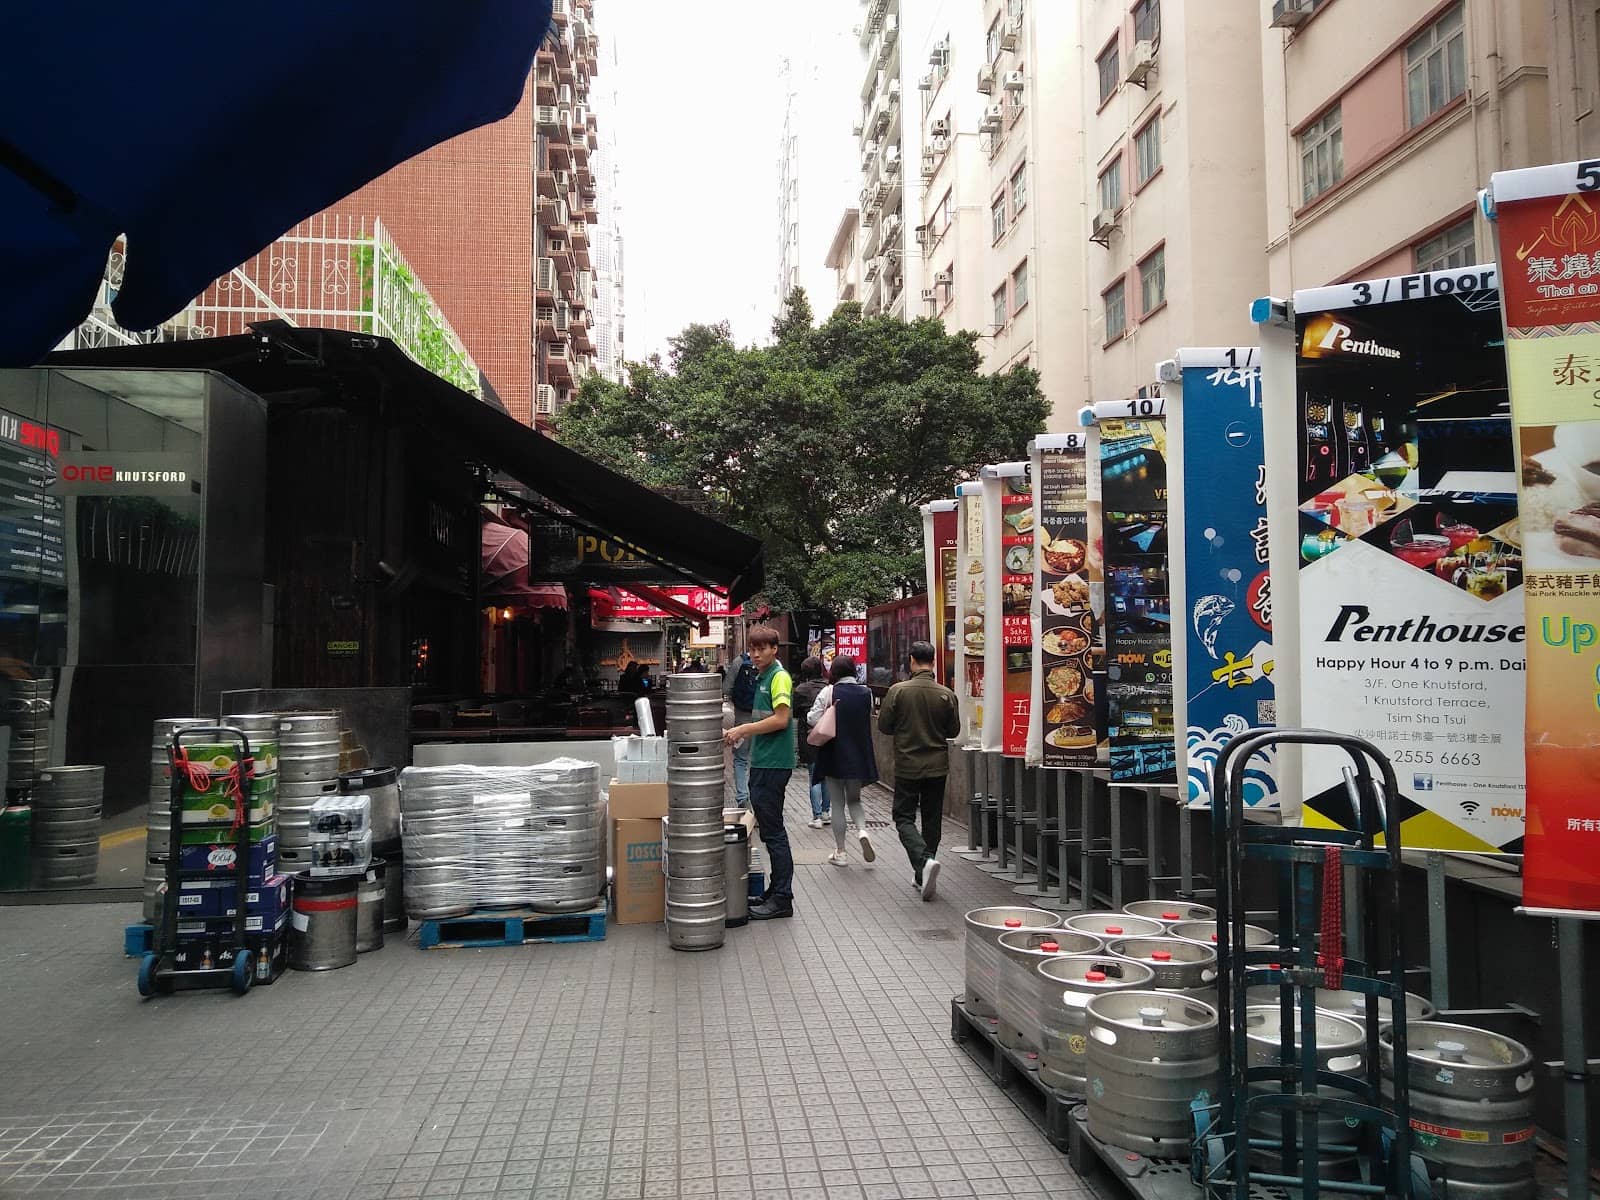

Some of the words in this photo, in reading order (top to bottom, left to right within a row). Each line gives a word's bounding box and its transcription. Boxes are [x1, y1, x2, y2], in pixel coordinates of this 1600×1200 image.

[1576, 161, 1600, 191] 5
[1401, 270, 1495, 300] Floor
[1537, 283, 1574, 298] Thai
[1578, 283, 1598, 295] on
[1318, 321, 1401, 359] Penthouse
[1552, 354, 1600, 386] 泰
[1127, 400, 1153, 416] 10
[1066, 434, 1078, 447] 8
[1558, 590, 1590, 598] Knuckle
[1324, 604, 1525, 644] Penthouse
[838, 636, 851, 646] ONE
[852, 636, 865, 645] WAY
[1115, 638, 1137, 646] Happy
[1541, 615, 1597, 655] Up
[838, 647, 860, 657] PIZZAS
[1117, 653, 1146, 664] now
[1316, 656, 1366, 672] Happy
[1370, 657, 1406, 669] Hour
[1410, 657, 1420, 669] 4
[1424, 658, 1439, 670] to
[1445, 658, 1453, 670] 9
[1458, 661, 1494, 673] p.m.
[1391, 679, 1418, 689] One
[1423, 679, 1488, 692] Knutsford,
[1364, 696, 1369, 705] 1
[1374, 696, 1433, 706] Knutsford
[1438, 697, 1491, 709] Terrace,
[1387, 713, 1412, 724] Tsim
[1416, 713, 1440, 724] Sha
[1443, 714, 1467, 725] Tsui
[1394, 750, 1434, 764] 2555
[1440, 752, 1481, 766] 6663
[1491, 807, 1522, 818] now
